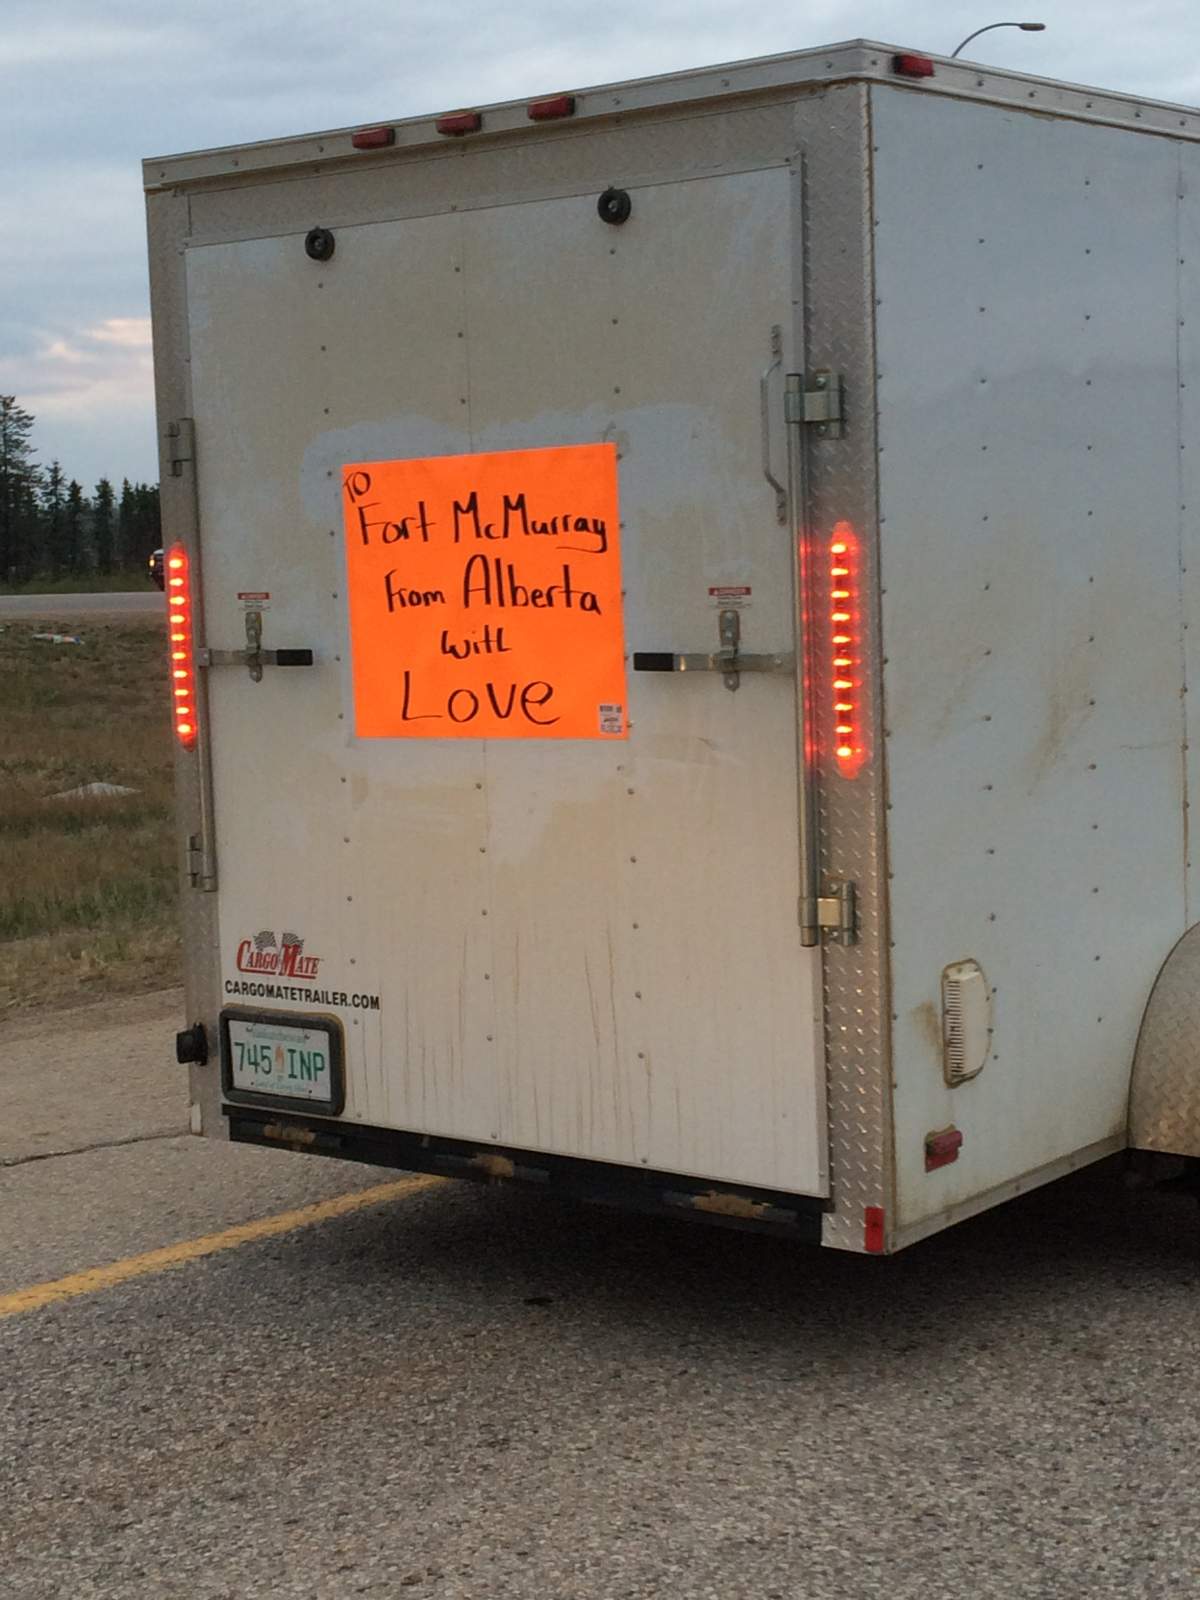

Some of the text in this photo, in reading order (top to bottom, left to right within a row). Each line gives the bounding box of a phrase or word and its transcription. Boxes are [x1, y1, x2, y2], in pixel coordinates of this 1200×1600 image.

[357, 491, 608, 553] Fort McMurray
[463, 553, 602, 615] Alberta
[224, 979, 381, 1010] CARGOMATETRAILER.COM
[234, 1041, 326, 1082] 745 INP
